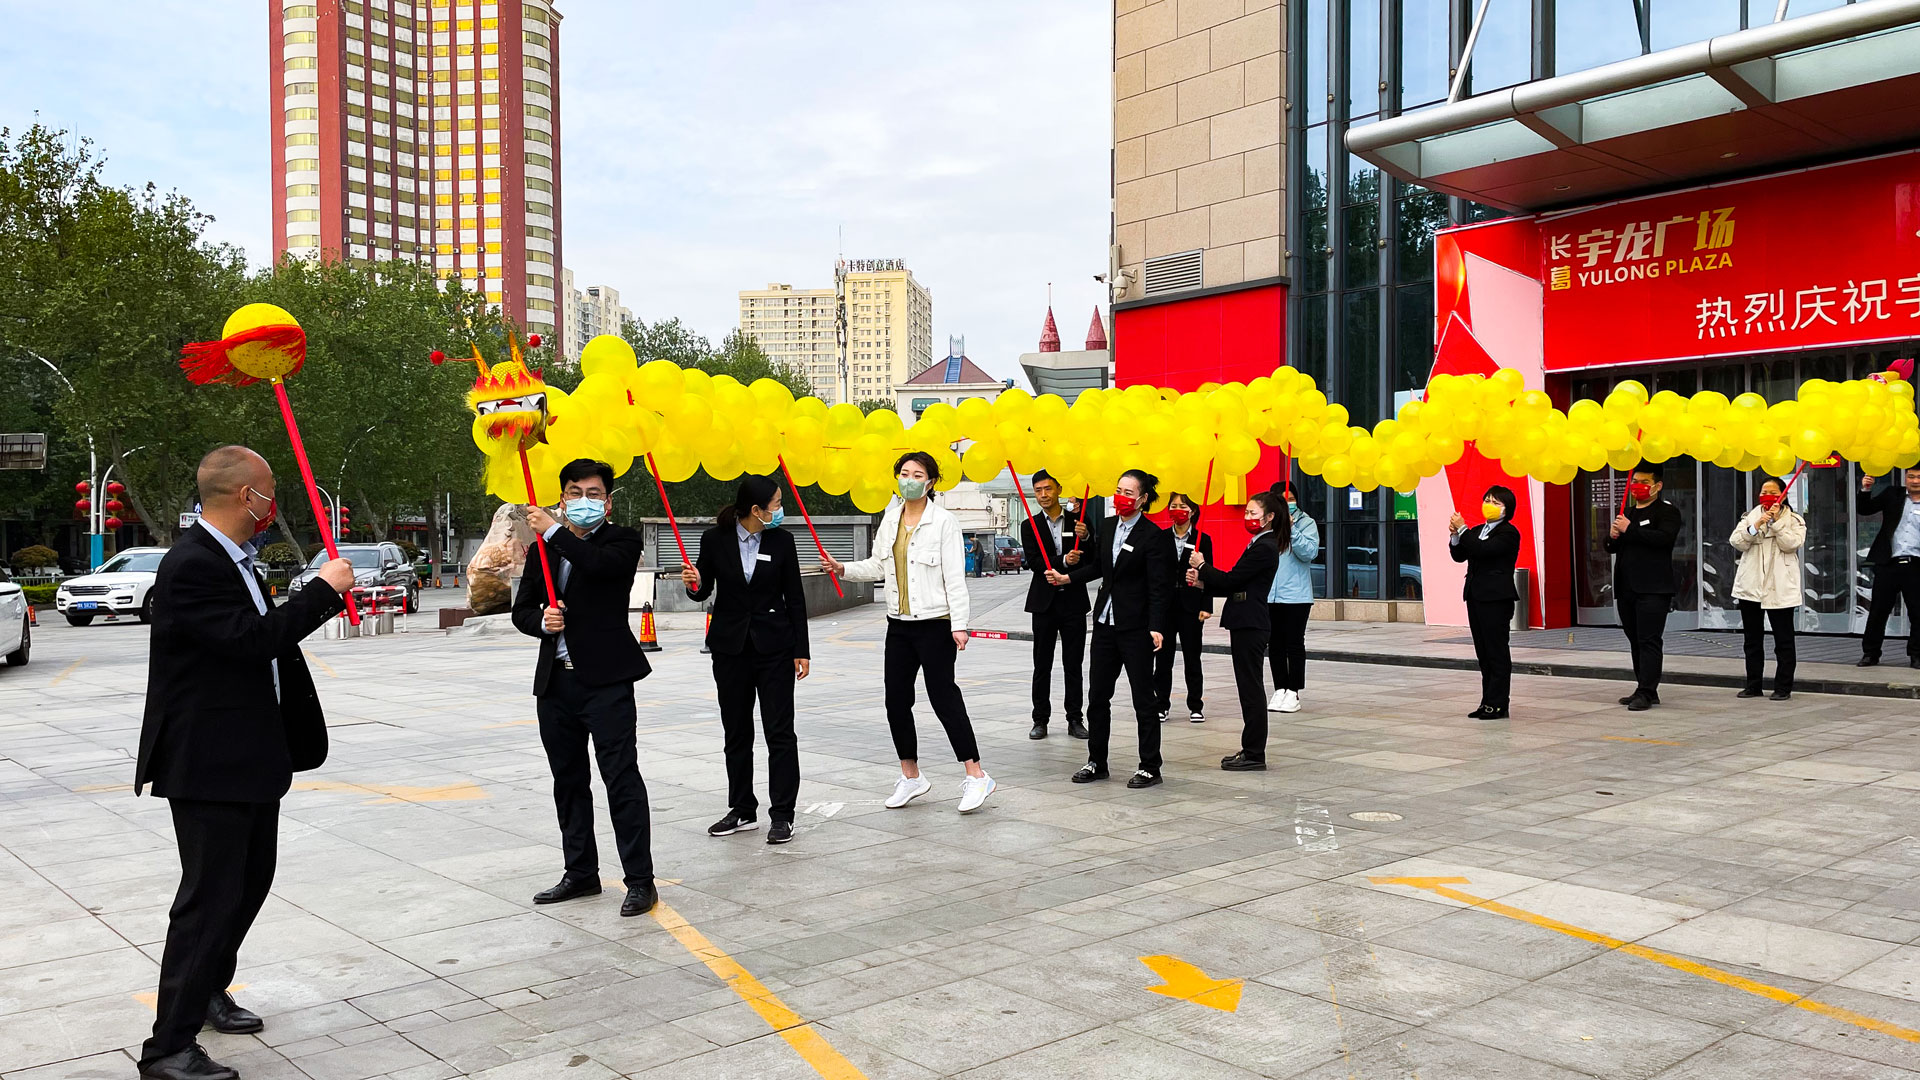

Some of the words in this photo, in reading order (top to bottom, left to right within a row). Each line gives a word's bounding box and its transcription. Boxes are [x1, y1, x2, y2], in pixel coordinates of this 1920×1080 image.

[1550, 233, 1572, 291] 长葛
[1576, 206, 1736, 268] 宇龙广场
[1577, 262, 1660, 288] YULONG
[1665, 252, 1733, 276] PLAZA
